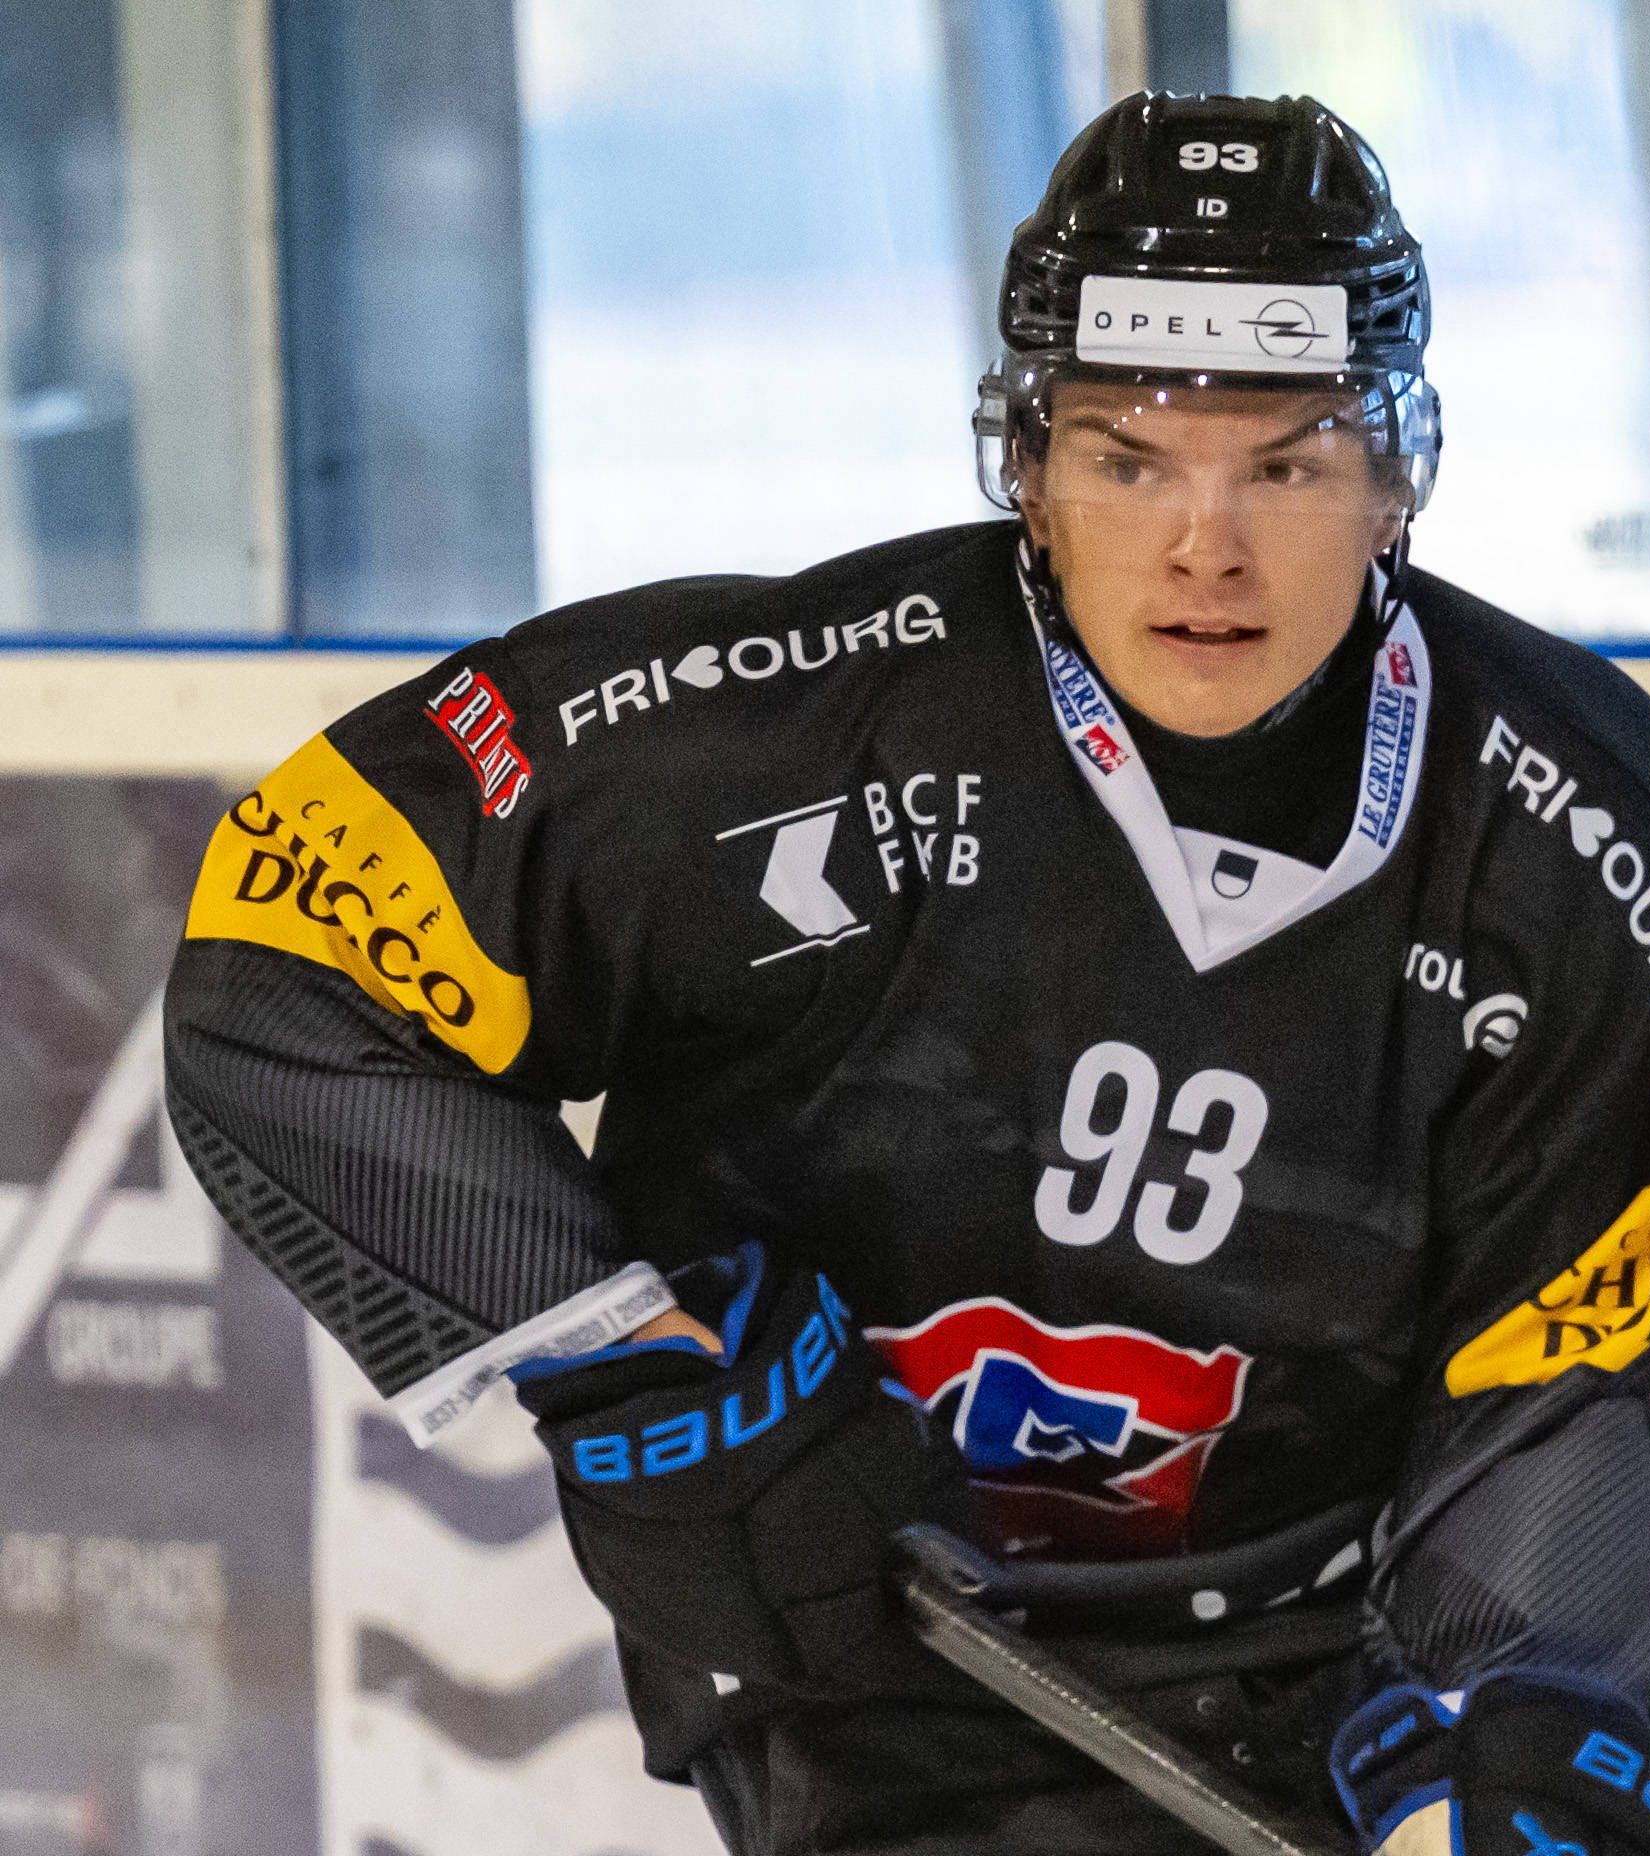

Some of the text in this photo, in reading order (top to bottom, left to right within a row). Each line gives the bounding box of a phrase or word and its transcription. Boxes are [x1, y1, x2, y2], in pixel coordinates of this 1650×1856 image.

[1178, 141, 1260, 173] 93
[1196, 198, 1228, 218] ID
[1094, 311, 1222, 338] OPEL
[1359, 804, 1384, 840] LE
[1034, 1040, 1269, 1265] 93
